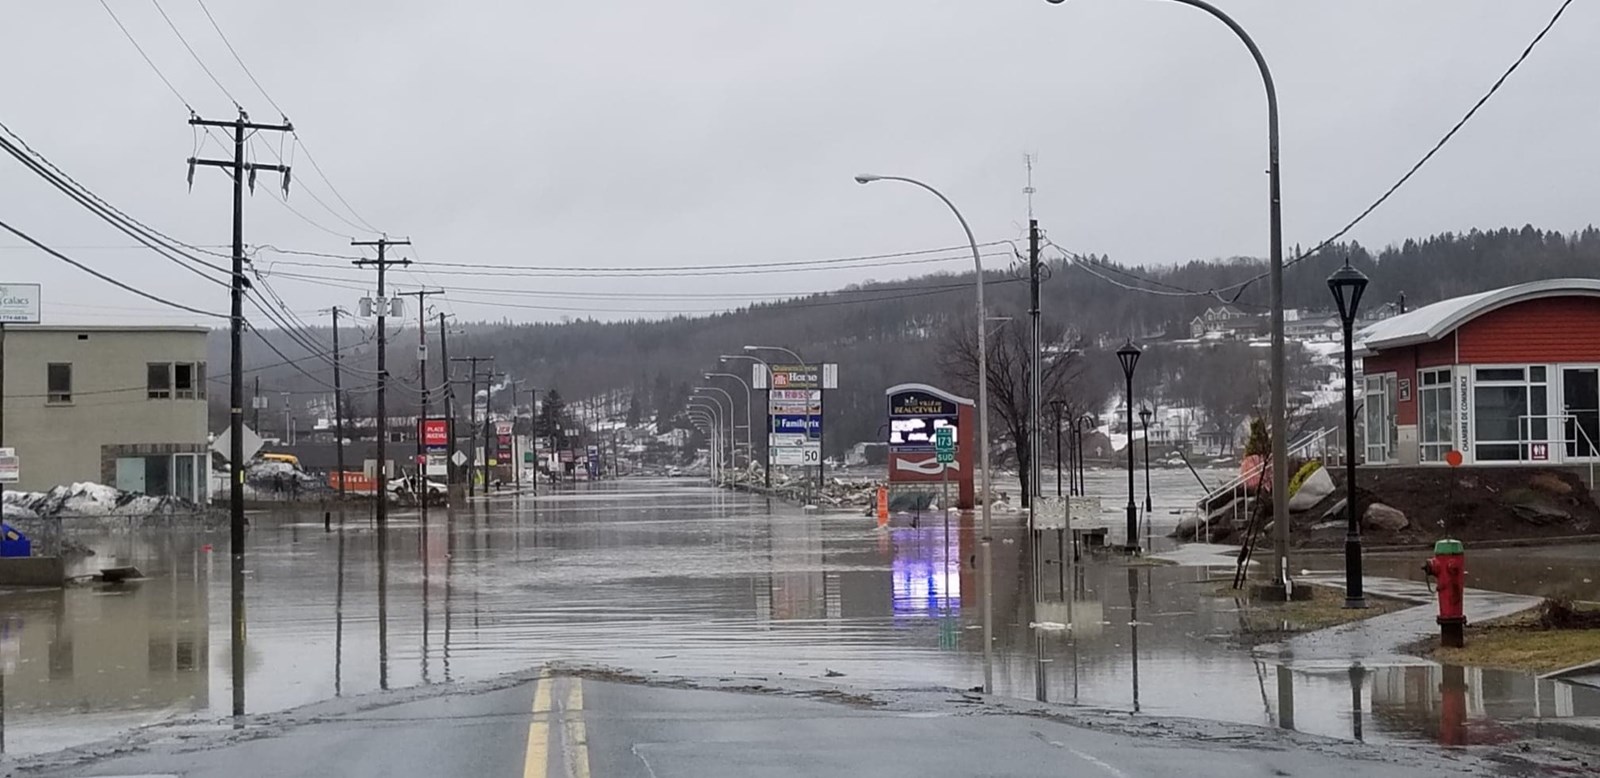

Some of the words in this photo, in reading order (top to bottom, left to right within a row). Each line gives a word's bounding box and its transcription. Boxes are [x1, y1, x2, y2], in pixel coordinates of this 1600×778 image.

[3, 296, 29, 304] calacs
[789, 372, 817, 381] Home
[785, 391, 814, 399] ROSSY
[1461, 412, 1468, 421] DE
[937, 437, 952, 446] 173
[1461, 422, 1469, 452] CHAMBRE
[804, 450, 818, 462] 50
[937, 453, 953, 461] SUD
